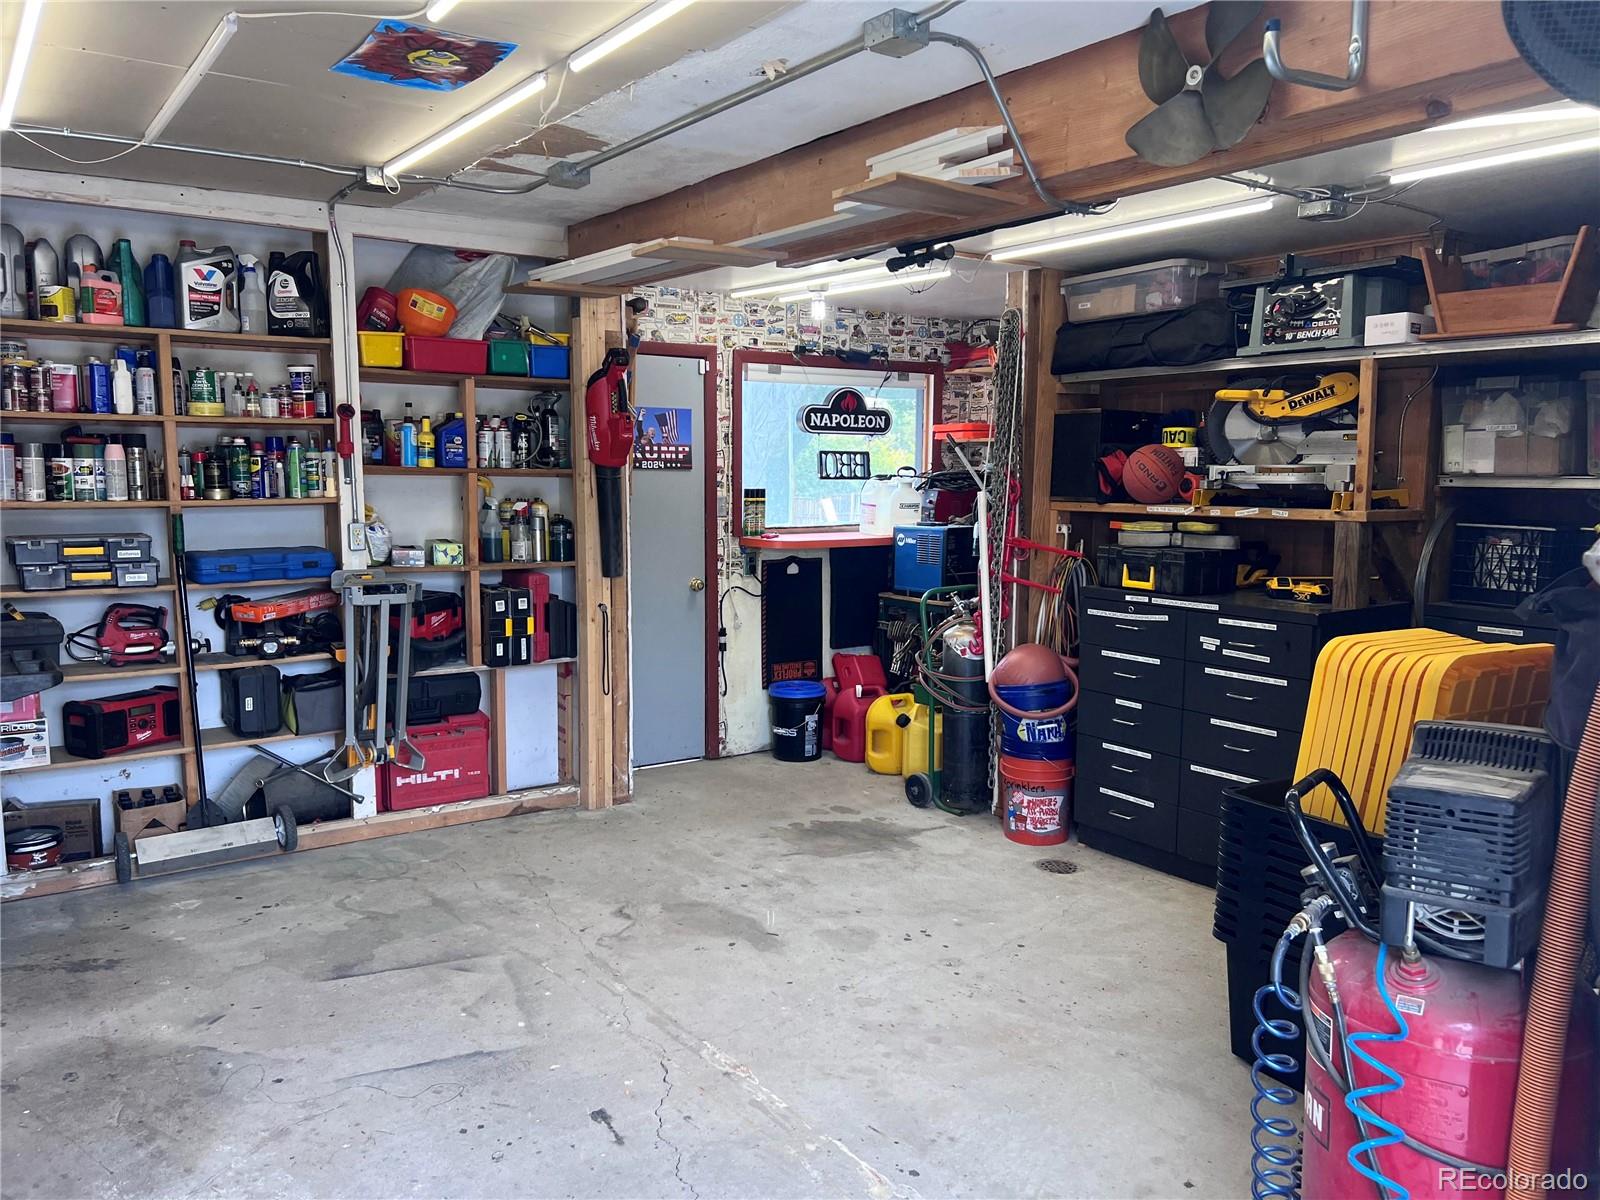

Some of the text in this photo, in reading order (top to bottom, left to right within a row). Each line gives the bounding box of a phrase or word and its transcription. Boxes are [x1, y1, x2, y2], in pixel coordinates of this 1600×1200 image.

[1312, 319, 1338, 328] DELTA
[1296, 329, 1321, 340] BENCH
[1321, 327, 1338, 337] SAW
[809, 413, 886, 429] NAPOLEON
[588, 415, 601, 452] Milwaukee
[632, 445, 690, 459] RUMP
[641, 460, 665, 469] 2024
[0, 723, 37, 733] RIDGID
[396, 768, 460, 787] HILTI
